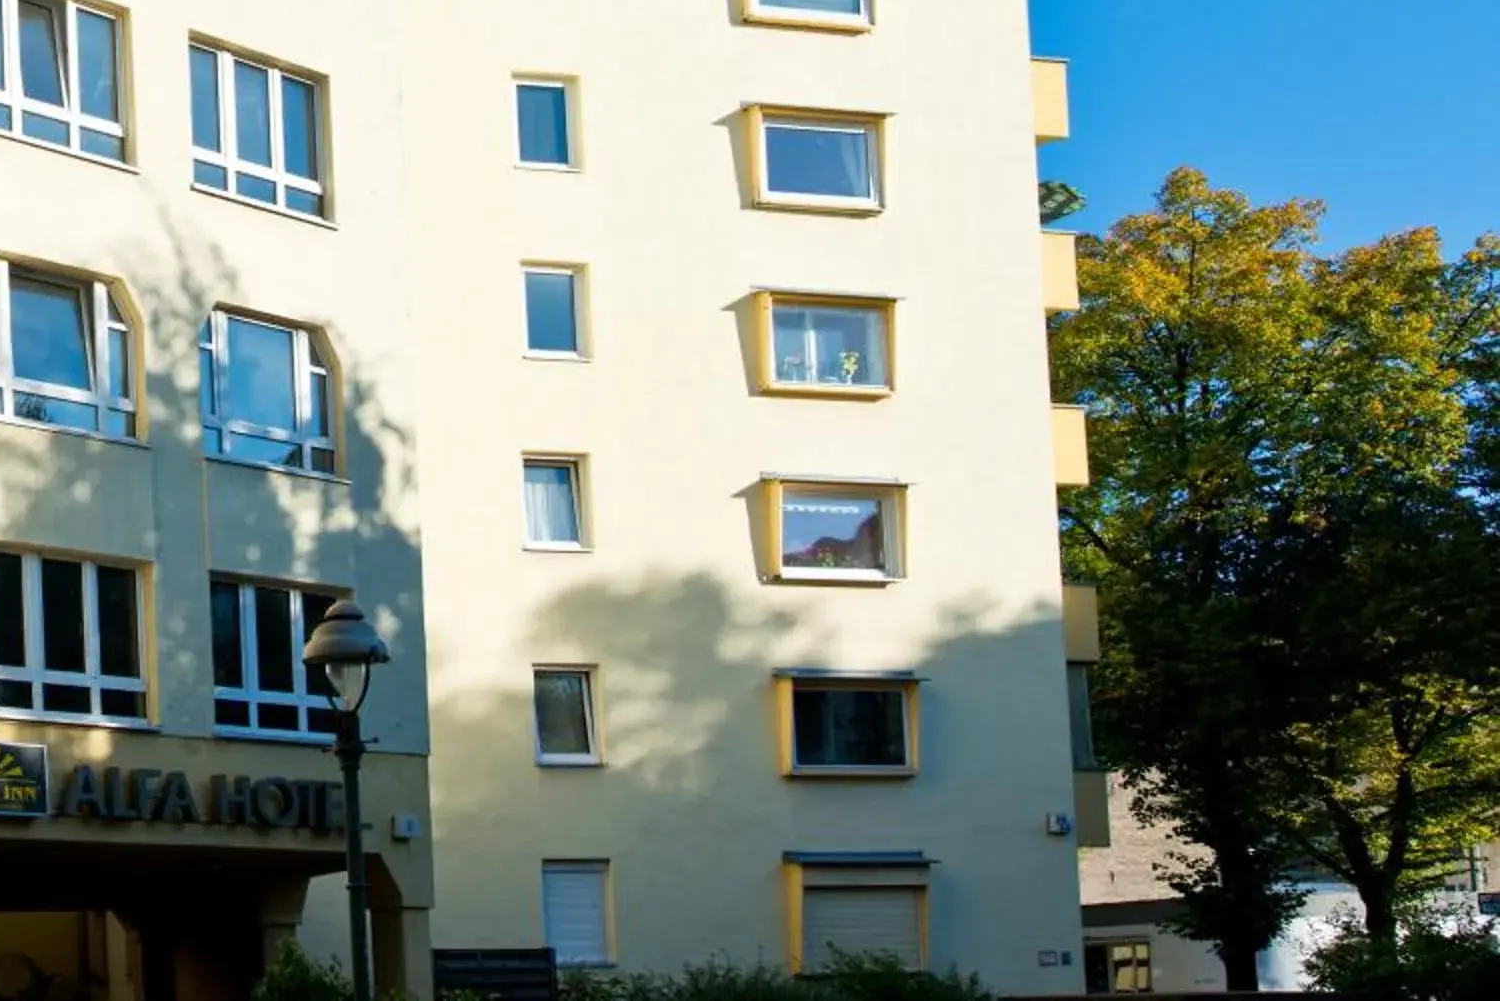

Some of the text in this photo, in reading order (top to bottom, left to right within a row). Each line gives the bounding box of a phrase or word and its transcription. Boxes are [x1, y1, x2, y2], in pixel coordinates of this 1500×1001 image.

[3, 784, 37, 802] INN
[65, 764, 372, 832] ALFA HOTE
